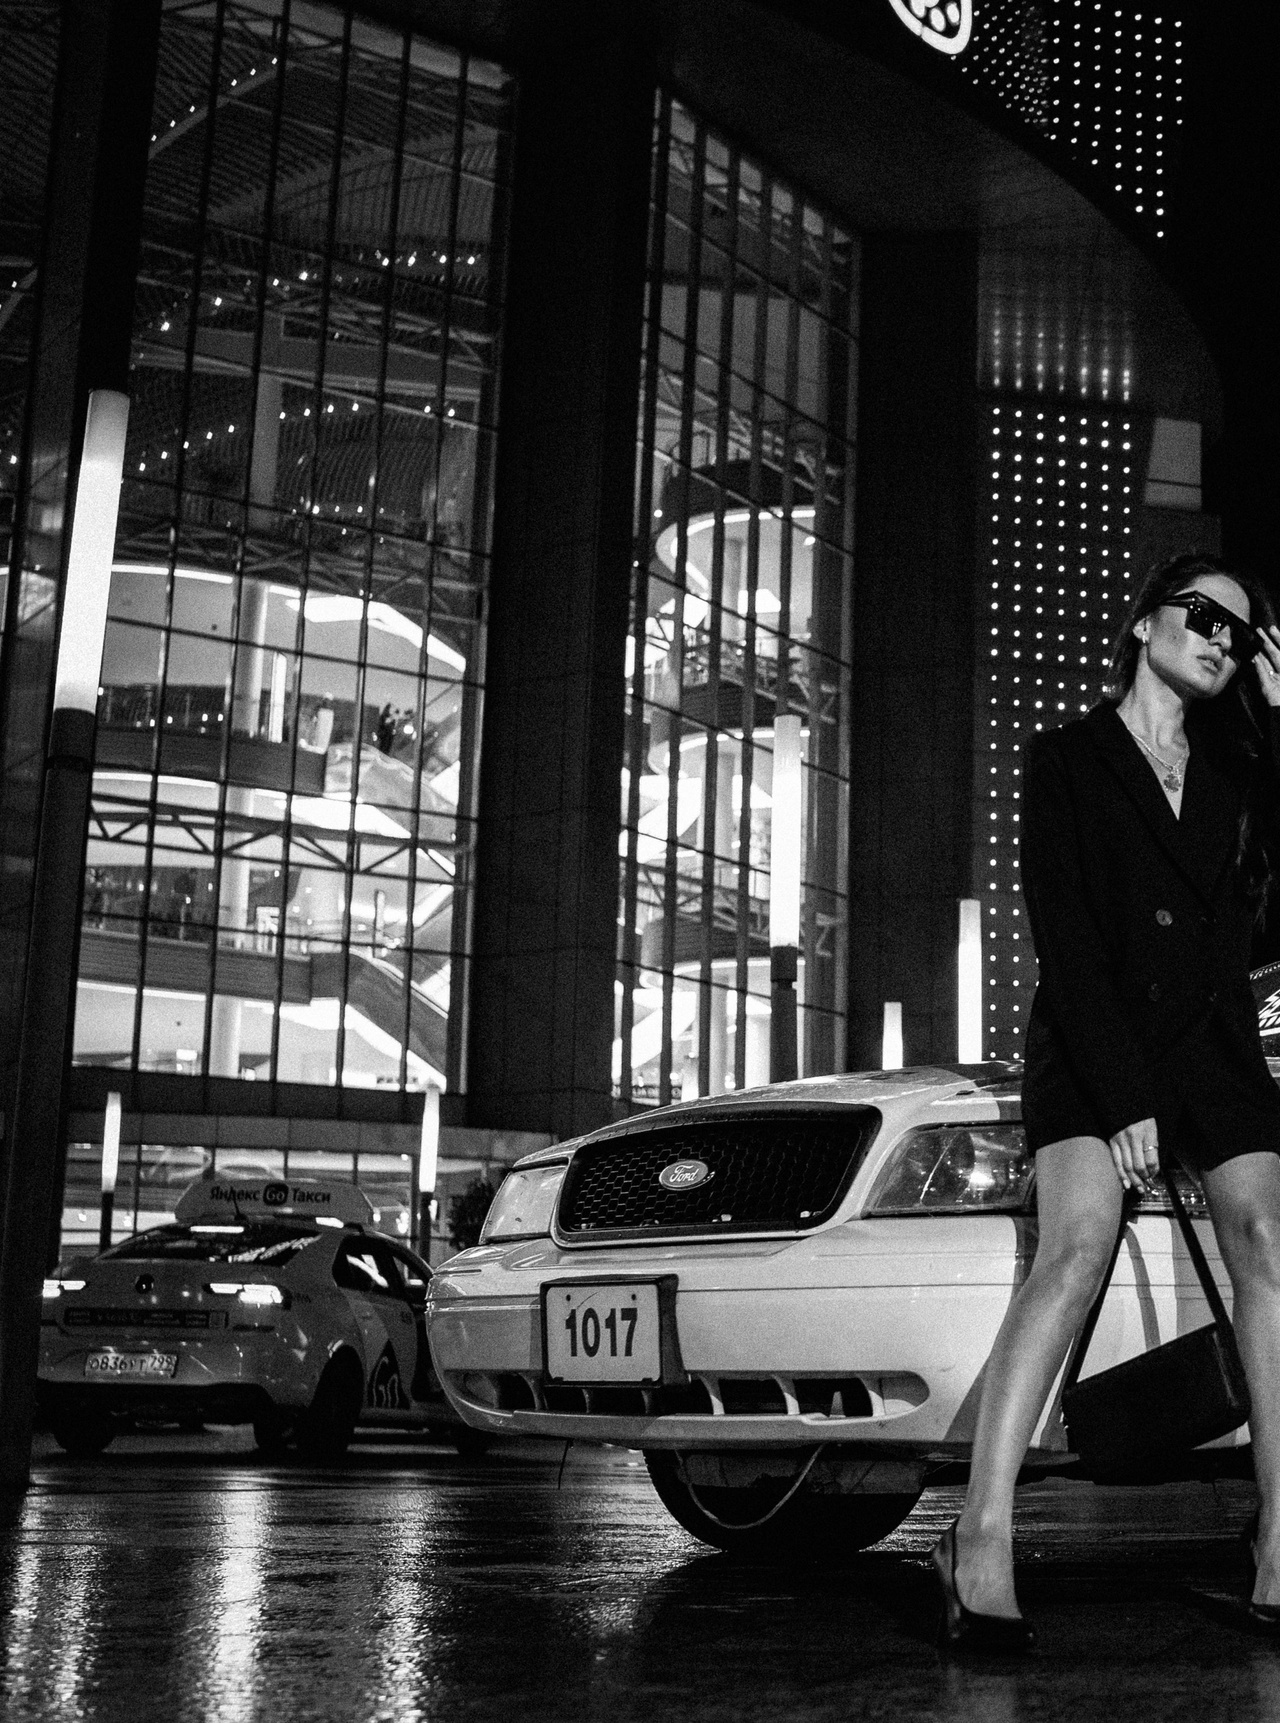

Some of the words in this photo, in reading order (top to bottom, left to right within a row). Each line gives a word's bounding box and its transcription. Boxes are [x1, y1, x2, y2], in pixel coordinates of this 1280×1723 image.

[669, 1164, 699, 1183] Ford
[210, 1186, 260, 1202] Яндекс
[292, 1187, 331, 1203] Такси
[565, 1307, 638, 1358] 1017
